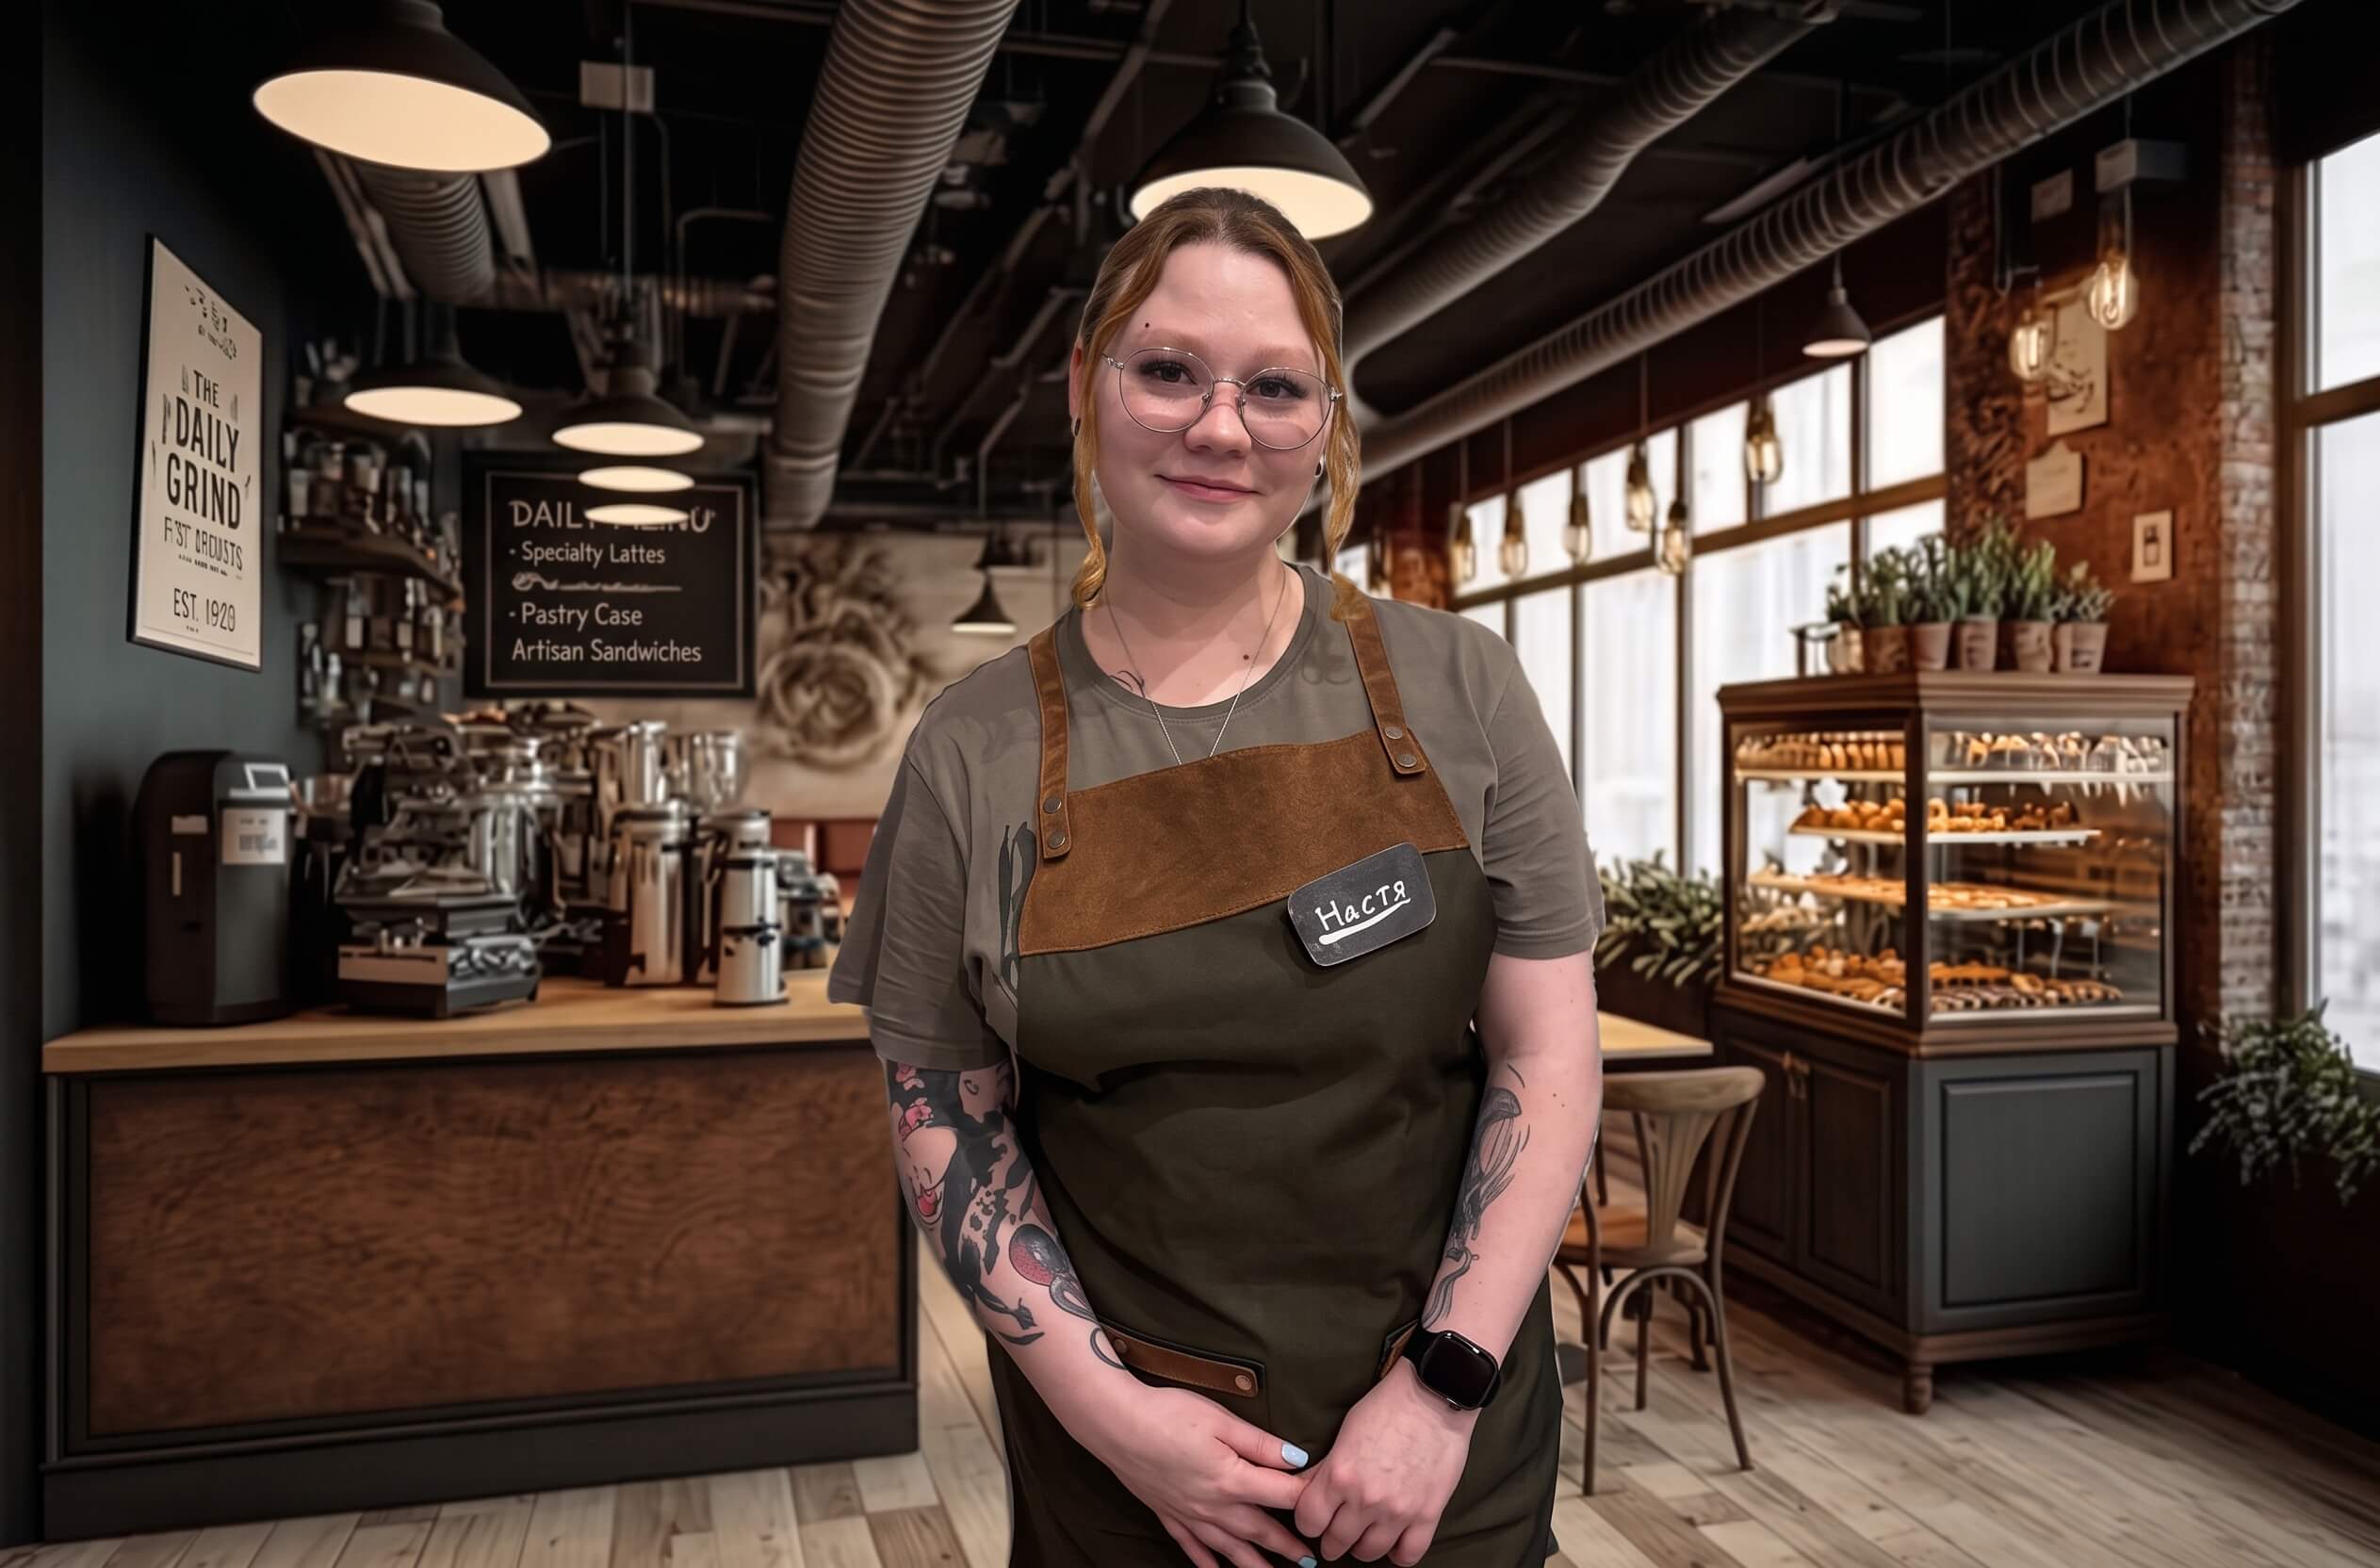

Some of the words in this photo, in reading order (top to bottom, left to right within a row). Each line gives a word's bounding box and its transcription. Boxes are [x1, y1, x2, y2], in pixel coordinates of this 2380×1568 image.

[193, 369, 220, 409] THE
[175, 396, 240, 473] DAILY
[167, 452, 241, 530] GRIND
[509, 500, 601, 530] DAIL
[522, 541, 603, 568] Specialty
[611, 543, 666, 564] Lattes
[173, 587, 199, 622] EST.
[205, 598, 236, 632] 1920
[522, 602, 589, 632] Pastry
[595, 603, 643, 626] Case
[512, 638, 584, 662] Artisan
[591, 639, 702, 662] Sandwiches
[1314, 880, 1406, 931] Настя
